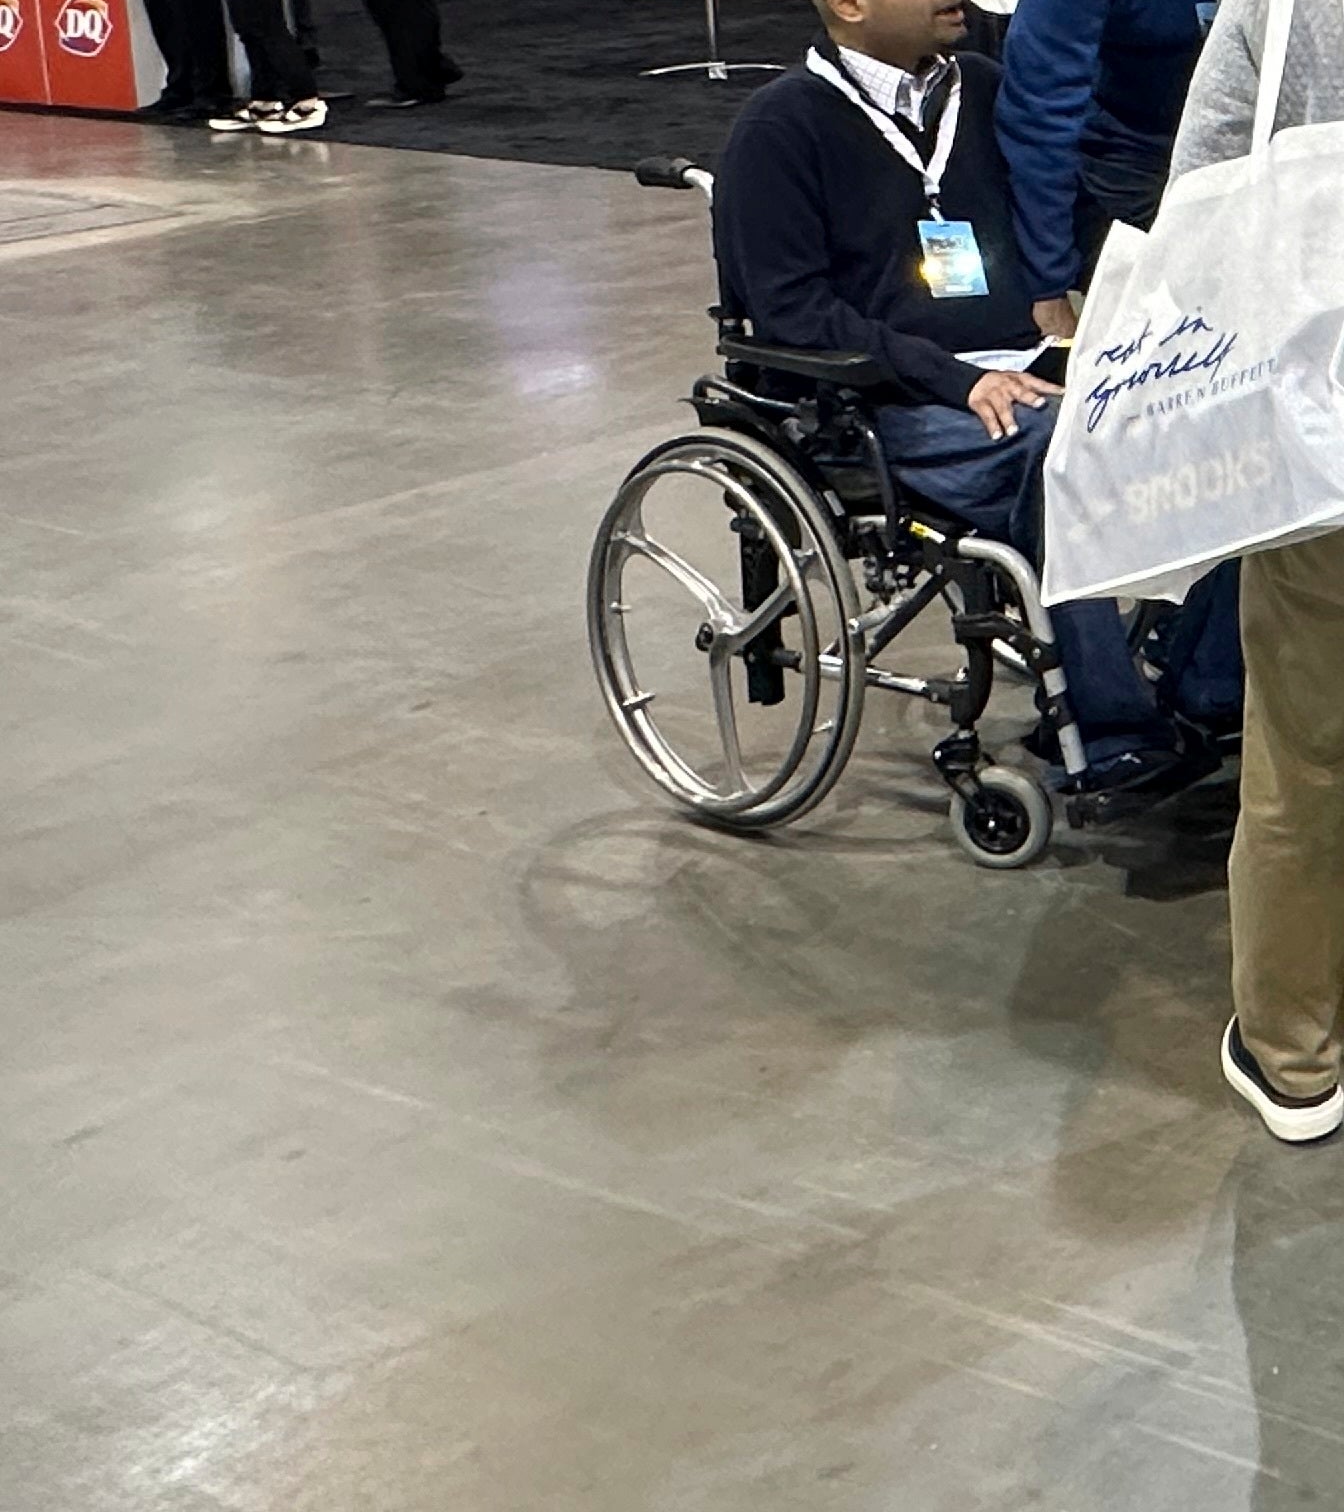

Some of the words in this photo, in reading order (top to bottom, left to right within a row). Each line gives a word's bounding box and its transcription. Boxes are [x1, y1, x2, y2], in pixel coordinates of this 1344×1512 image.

[0, 4, 14, 39] Q
[66, 8, 104, 43] DQ
[1147, 387, 1206, 417] WARREN
[1211, 357, 1278, 397] BUFFETT
